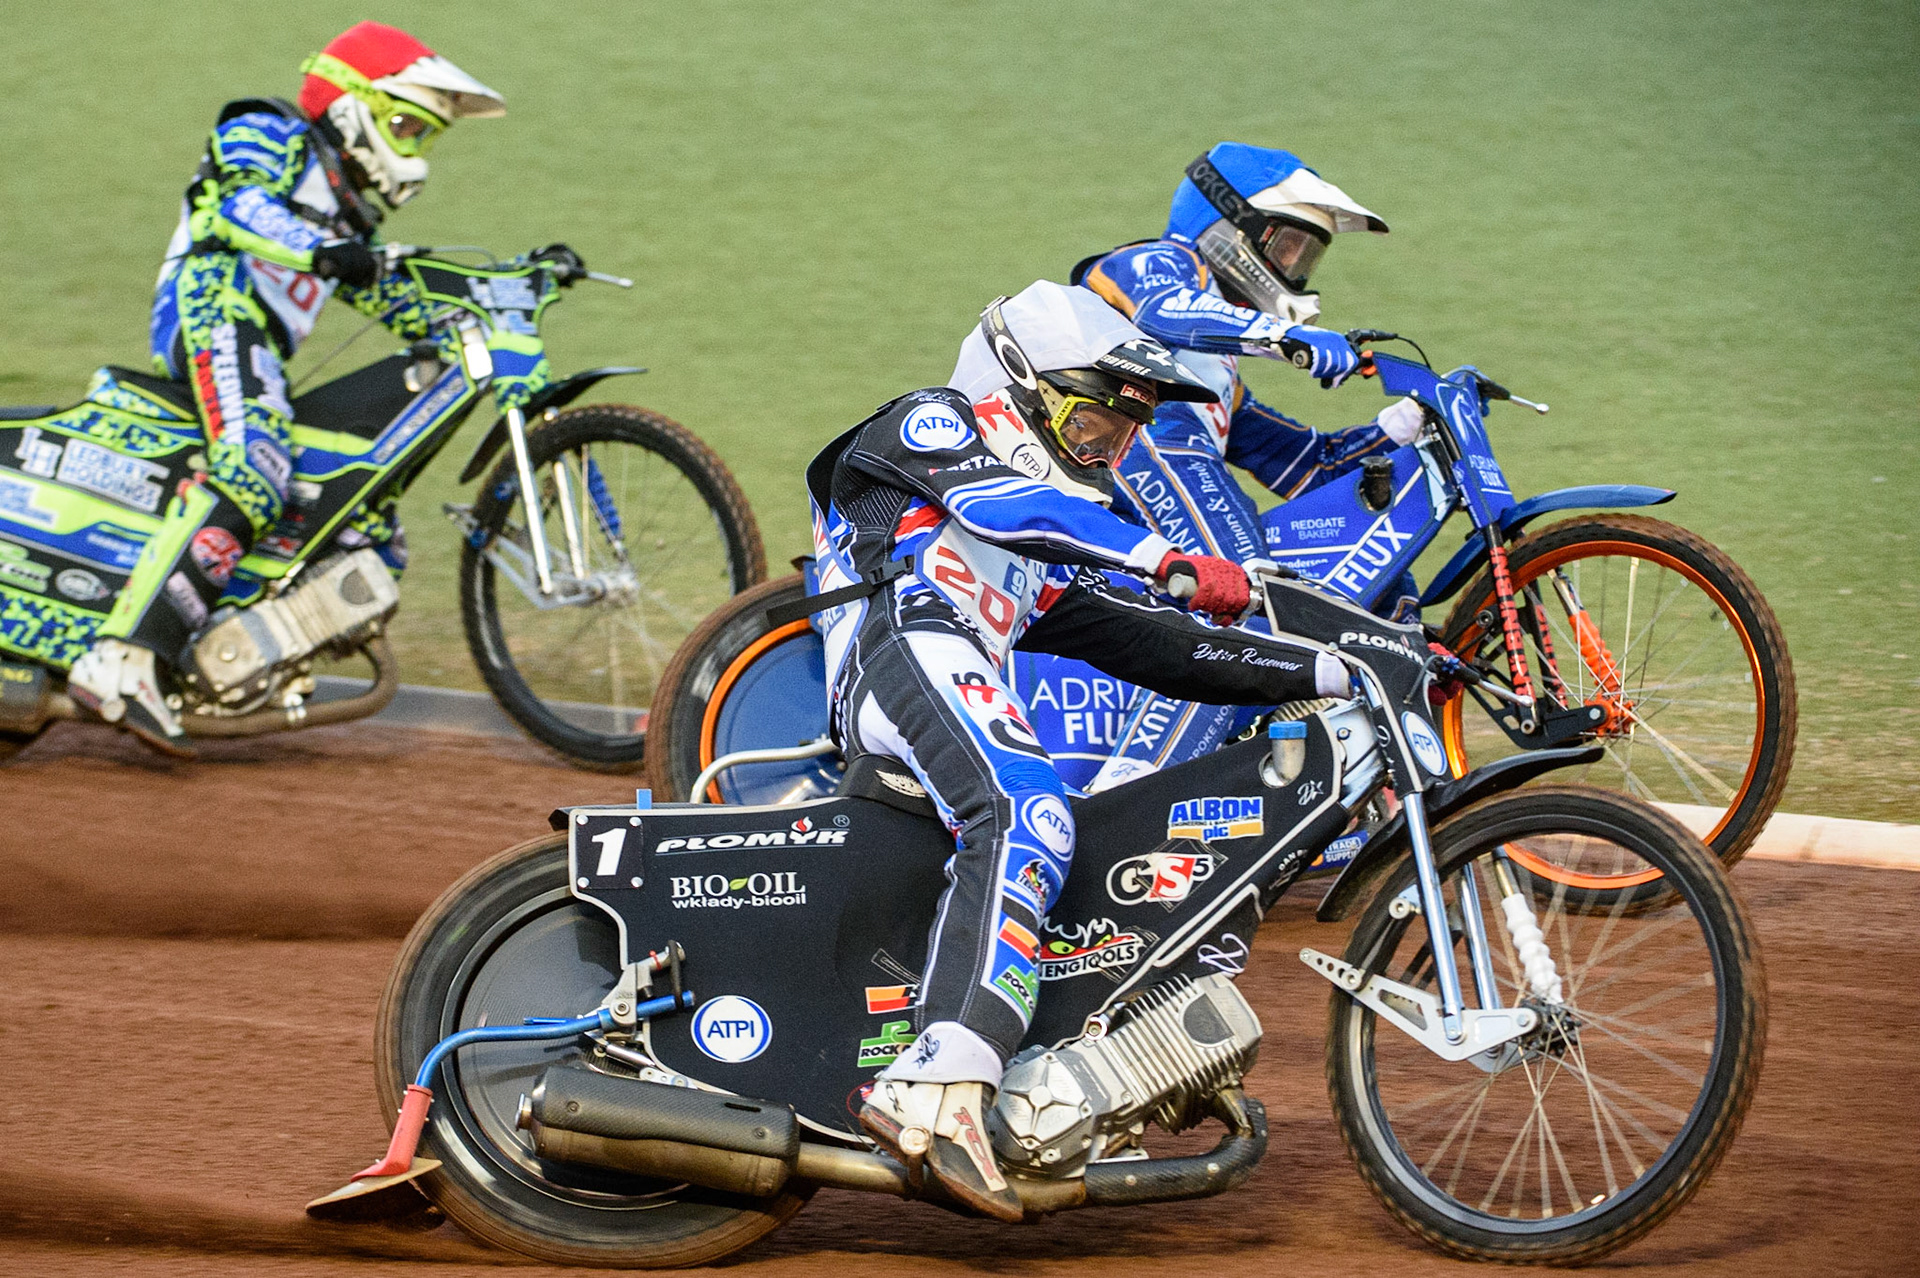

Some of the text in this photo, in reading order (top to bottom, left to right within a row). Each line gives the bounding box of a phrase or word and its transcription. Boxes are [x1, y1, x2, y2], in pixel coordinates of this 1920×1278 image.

[914, 416, 960, 434] ATPI
[1018, 452, 1044, 477] ATPI
[1479, 470, 1504, 488] FLUX
[1126, 470, 1195, 554] ADRIAN
[1206, 496, 1230, 512] &
[1290, 516, 1346, 530] REDGATE
[1298, 529, 1340, 540] BAKERY
[1334, 516, 1414, 594] FLUX
[935, 545, 1016, 637] 20
[1241, 647, 1304, 671] Racewear
[1063, 711, 1125, 747] FLU
[1411, 732, 1438, 754] ATPI
[1168, 796, 1263, 823] ALBON
[1037, 809, 1072, 844] ATPI
[1202, 825, 1230, 843] plc
[591, 827, 628, 876] 1
[1002, 971, 1030, 1000] ROCK
[706, 1019, 756, 1039] ATPI
[860, 1044, 901, 1058] ROCK
